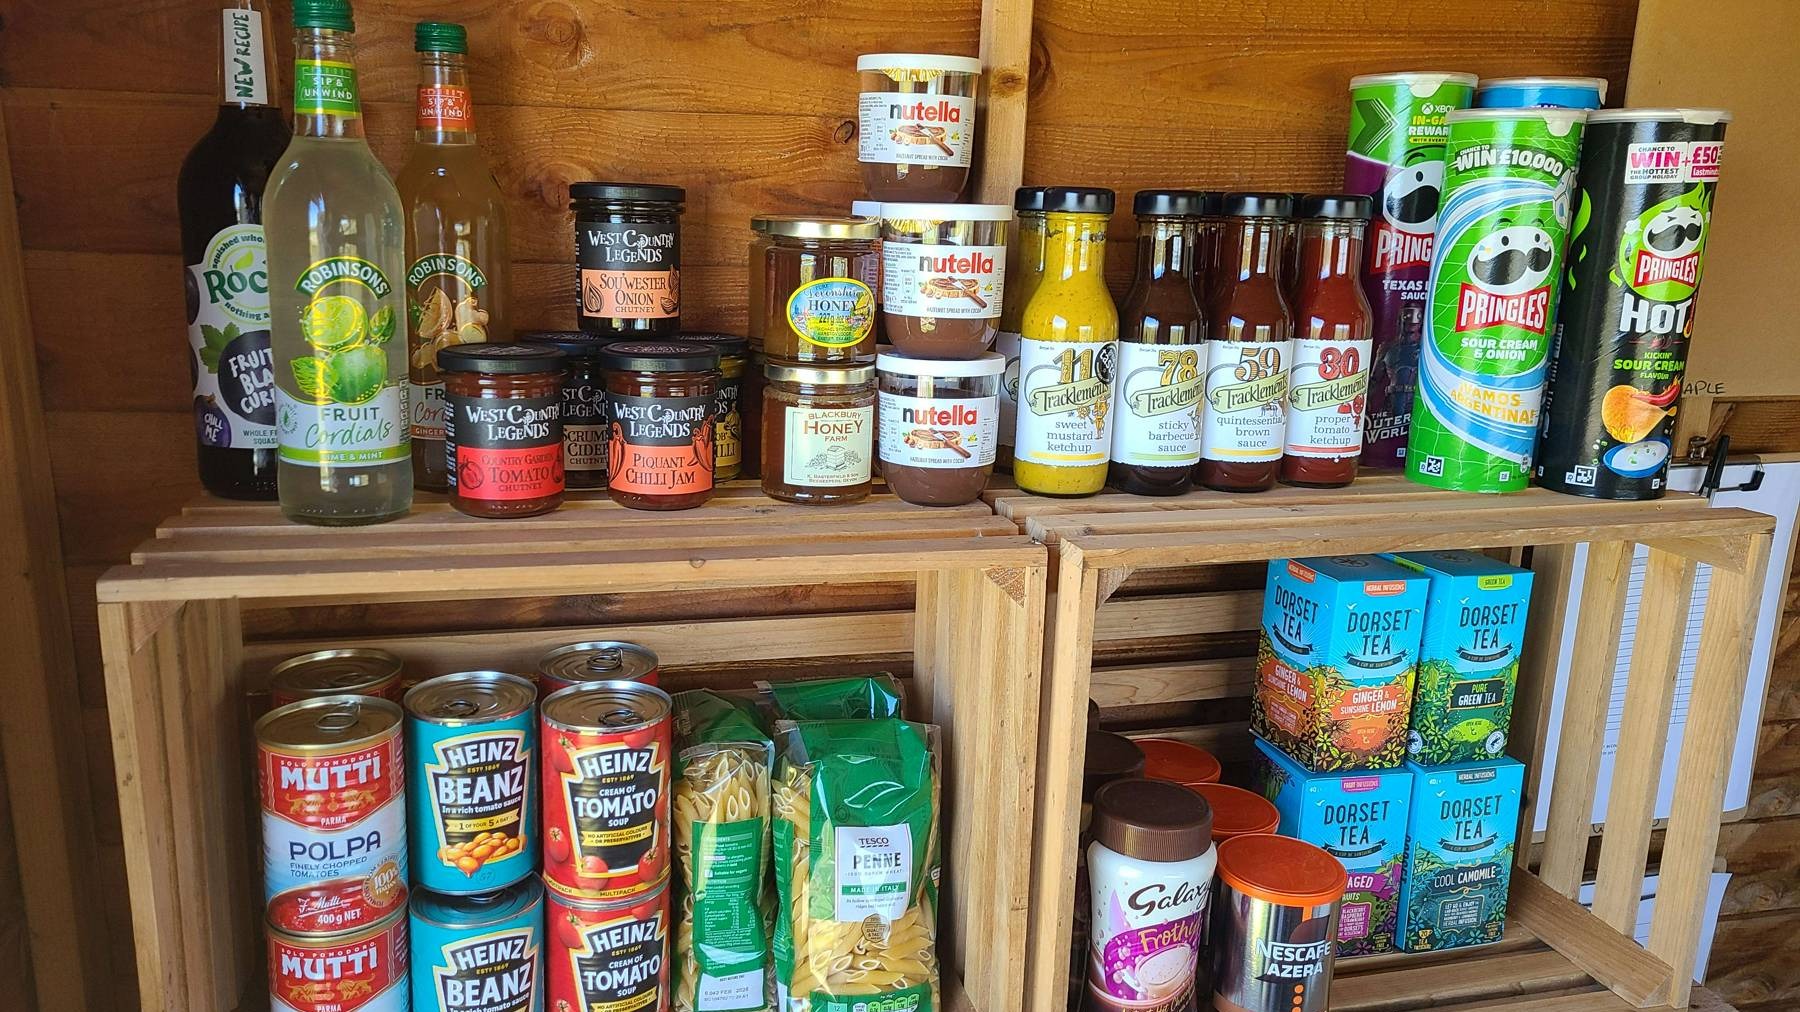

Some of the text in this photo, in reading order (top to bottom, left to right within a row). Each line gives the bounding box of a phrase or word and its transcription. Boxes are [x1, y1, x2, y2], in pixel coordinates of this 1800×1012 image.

[231, 12, 254, 98] NEW RECIPE
[313, 77, 332, 86] SIP
[304, 88, 353, 100] UNWIND
[889, 101, 961, 123] nutella
[1412, 116, 1447, 125] IN-GA
[1408, 126, 1448, 136] REWAR
[1456, 149, 1563, 177] WIN £10,000
[1631, 152, 1681, 168] WIN
[605, 247, 662, 263] LEGENDS
[919, 252, 994, 274] nutella
[1638, 255, 1697, 284] PRINGLES
[1382, 280, 1422, 291] TEXAS
[615, 290, 654, 306] ONION
[809, 300, 858, 312] HONEY
[1461, 291, 1547, 328] PRINGLES
[1619, 293, 1693, 334] HOT
[1461, 337, 1538, 350] SOUR CREAM
[1318, 346, 1360, 380] 30
[1474, 349, 1526, 361] & ONION
[1053, 347, 1093, 384] 11
[1158, 349, 1199, 387] 78
[1234, 347, 1281, 381] 59
[1613, 360, 1685, 372] SOUR CREAM
[1034, 382, 1109, 412] Tracklements
[204, 412, 224, 431] CHILL
[320, 407, 380, 421] FRUIT
[808, 411, 862, 420] BLACKBURY
[902, 404, 977, 426] nutella
[1216, 416, 1283, 427] quintessential
[1315, 416, 1351, 425] proper
[488, 423, 550, 441] LEGENDS
[630, 421, 691, 439] LEGENDS
[804, 419, 863, 435] HONEY
[1055, 420, 1087, 429] sweet
[1158, 420, 1190, 431] sticky
[1235, 426, 1271, 436] brown
[1314, 425, 1350, 434] tomato
[205, 426, 220, 442] ME
[305, 418, 394, 449] Cordials
[1047, 430, 1093, 441] mustard
[1149, 430, 1195, 441] barbecue
[1310, 436, 1351, 446] ketchup
[1047, 441, 1092, 453] ketchup
[1158, 444, 1187, 452] sauce
[1237, 439, 1267, 448] sauce
[359, 451, 383, 460] MINT
[633, 453, 686, 469] PIQUANT
[489, 466, 550, 484] TOMATO
[626, 468, 696, 490] CHILLI JAM
[1275, 584, 1320, 625] DORSET
[1347, 609, 1412, 634] DORSET
[1460, 603, 1518, 627] DORSET
[1282, 612, 1303, 642] TEA
[1362, 634, 1391, 656] TEA
[1473, 628, 1500, 650] TEA
[1286, 682, 1308, 703] LEMON
[1471, 683, 1488, 693] PURE
[1352, 691, 1383, 704] GINGER
[1458, 692, 1496, 706] GREEN TEA
[1340, 700, 1398, 715] SUNSHINE LEMON
[280, 751, 379, 768] SOLO POMODORO
[448, 741, 517, 769] HEINZ
[281, 756, 381, 792] MUTTI
[583, 752, 650, 779] HEINZ
[438, 765, 524, 805] BEANZ
[599, 785, 636, 796] CREAM OF
[458, 806, 474, 814] rich
[474, 803, 502, 814] tomato
[503, 796, 522, 808] sauce
[574, 788, 656, 818] TOMATO
[1440, 795, 1503, 820] DORSET
[321, 816, 347, 827] PARMA
[1323, 801, 1390, 825] DORSET
[458, 822, 464, 830] 1
[488, 818, 495, 827] 5
[608, 817, 629, 827] SOUP
[1455, 820, 1483, 841] TEA
[858, 837, 889, 846] TESCO
[1339, 825, 1369, 846] TEA
[289, 831, 382, 861] POLPA
[290, 855, 368, 870] FINELY CHOPPED
[853, 852, 901, 869] PENNE
[290, 869, 340, 878] TOMATOES
[1434, 866, 1496, 888] COOL CAMOMILE
[599, 887, 636, 897] MULTIPACK
[1128, 881, 1214, 917] Galaxy
[317, 913, 334, 924] 400
[343, 908, 361, 922] NET
[592, 921, 656, 953] HEINZ
[313, 941, 376, 958] POMODORO
[456, 938, 525, 971] HEINZ
[281, 946, 379, 980] MUTTI
[608, 954, 644, 969] CREAM OF
[1266, 961, 1323, 978] AZERA
[584, 954, 661, 992] TOMATO
[446, 961, 532, 1007] BEANZ
[617, 986, 637, 997] SOUP
